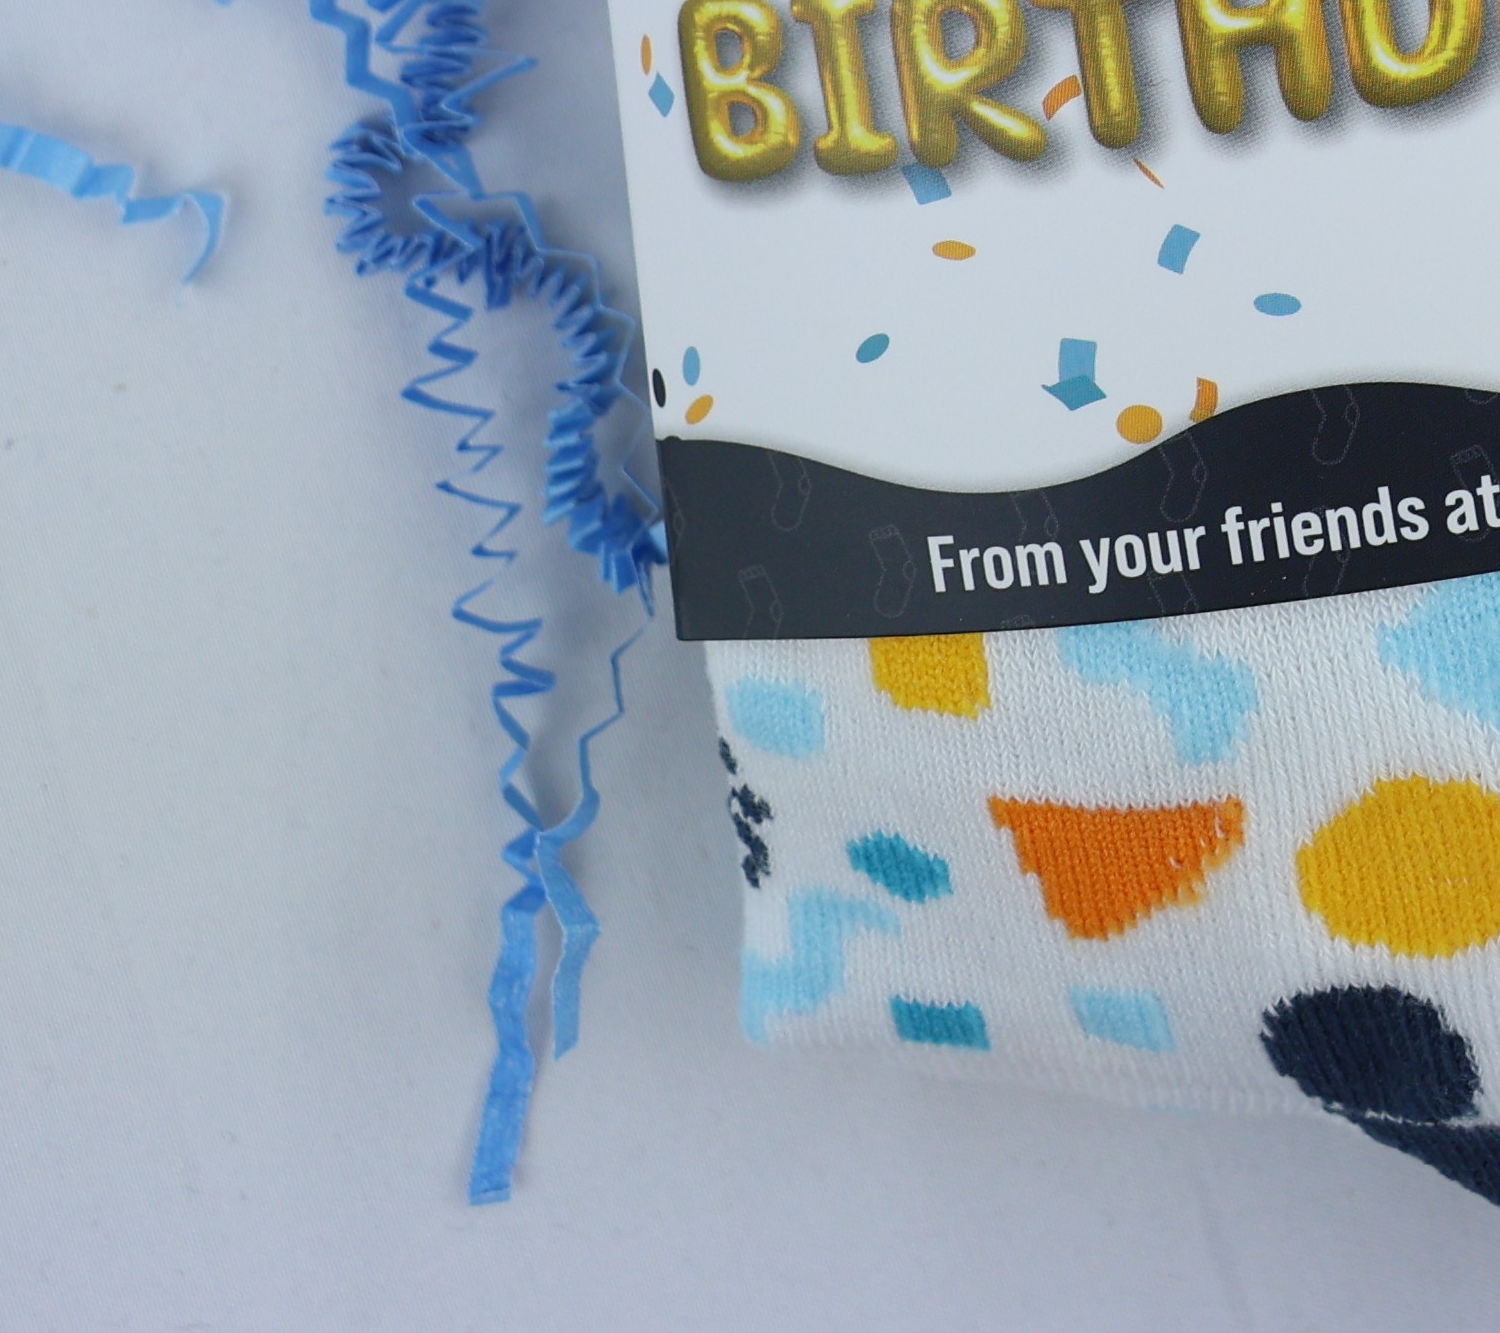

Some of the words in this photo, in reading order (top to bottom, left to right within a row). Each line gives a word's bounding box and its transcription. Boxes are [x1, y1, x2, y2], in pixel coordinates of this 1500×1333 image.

[927, 535, 1067, 593] From
[1080, 523, 1205, 594] your
[1221, 486, 1429, 566] friends
